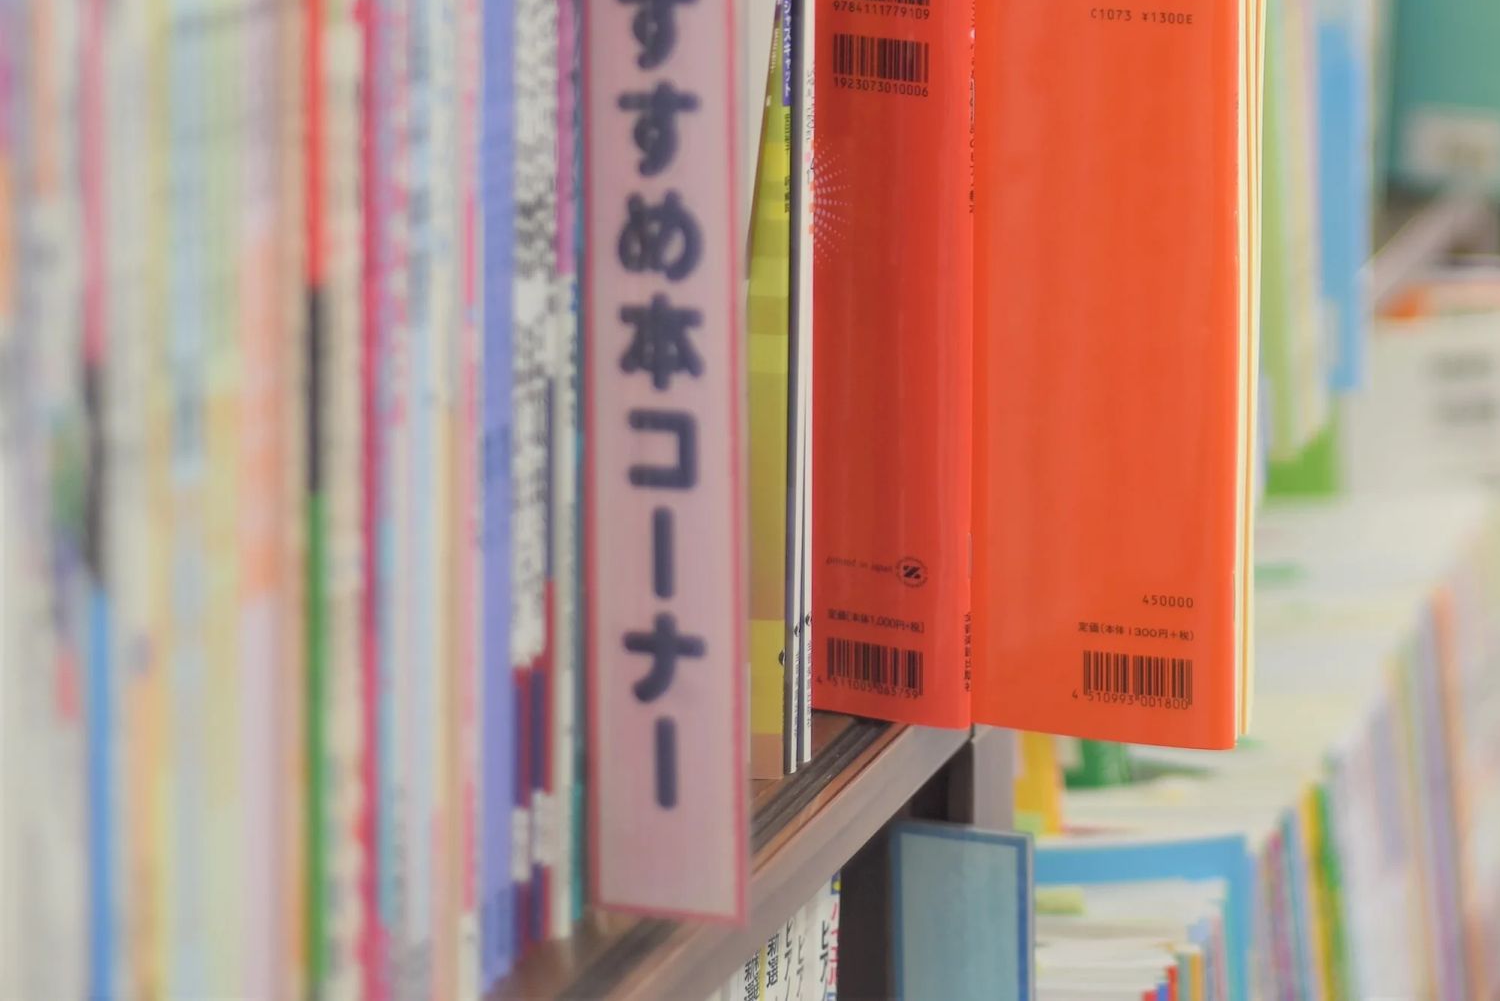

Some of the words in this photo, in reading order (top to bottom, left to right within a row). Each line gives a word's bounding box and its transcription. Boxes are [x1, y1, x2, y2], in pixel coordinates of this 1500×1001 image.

[833, 0, 930, 20] 9784111779109
[1090, 8, 1132, 22] C1073
[1142, 11, 1193, 25] ¥1300E
[833, 77, 929, 98] 1923073010006
[1142, 595, 1194, 609] 450000
[1140, 695, 1190, 711] 001800
